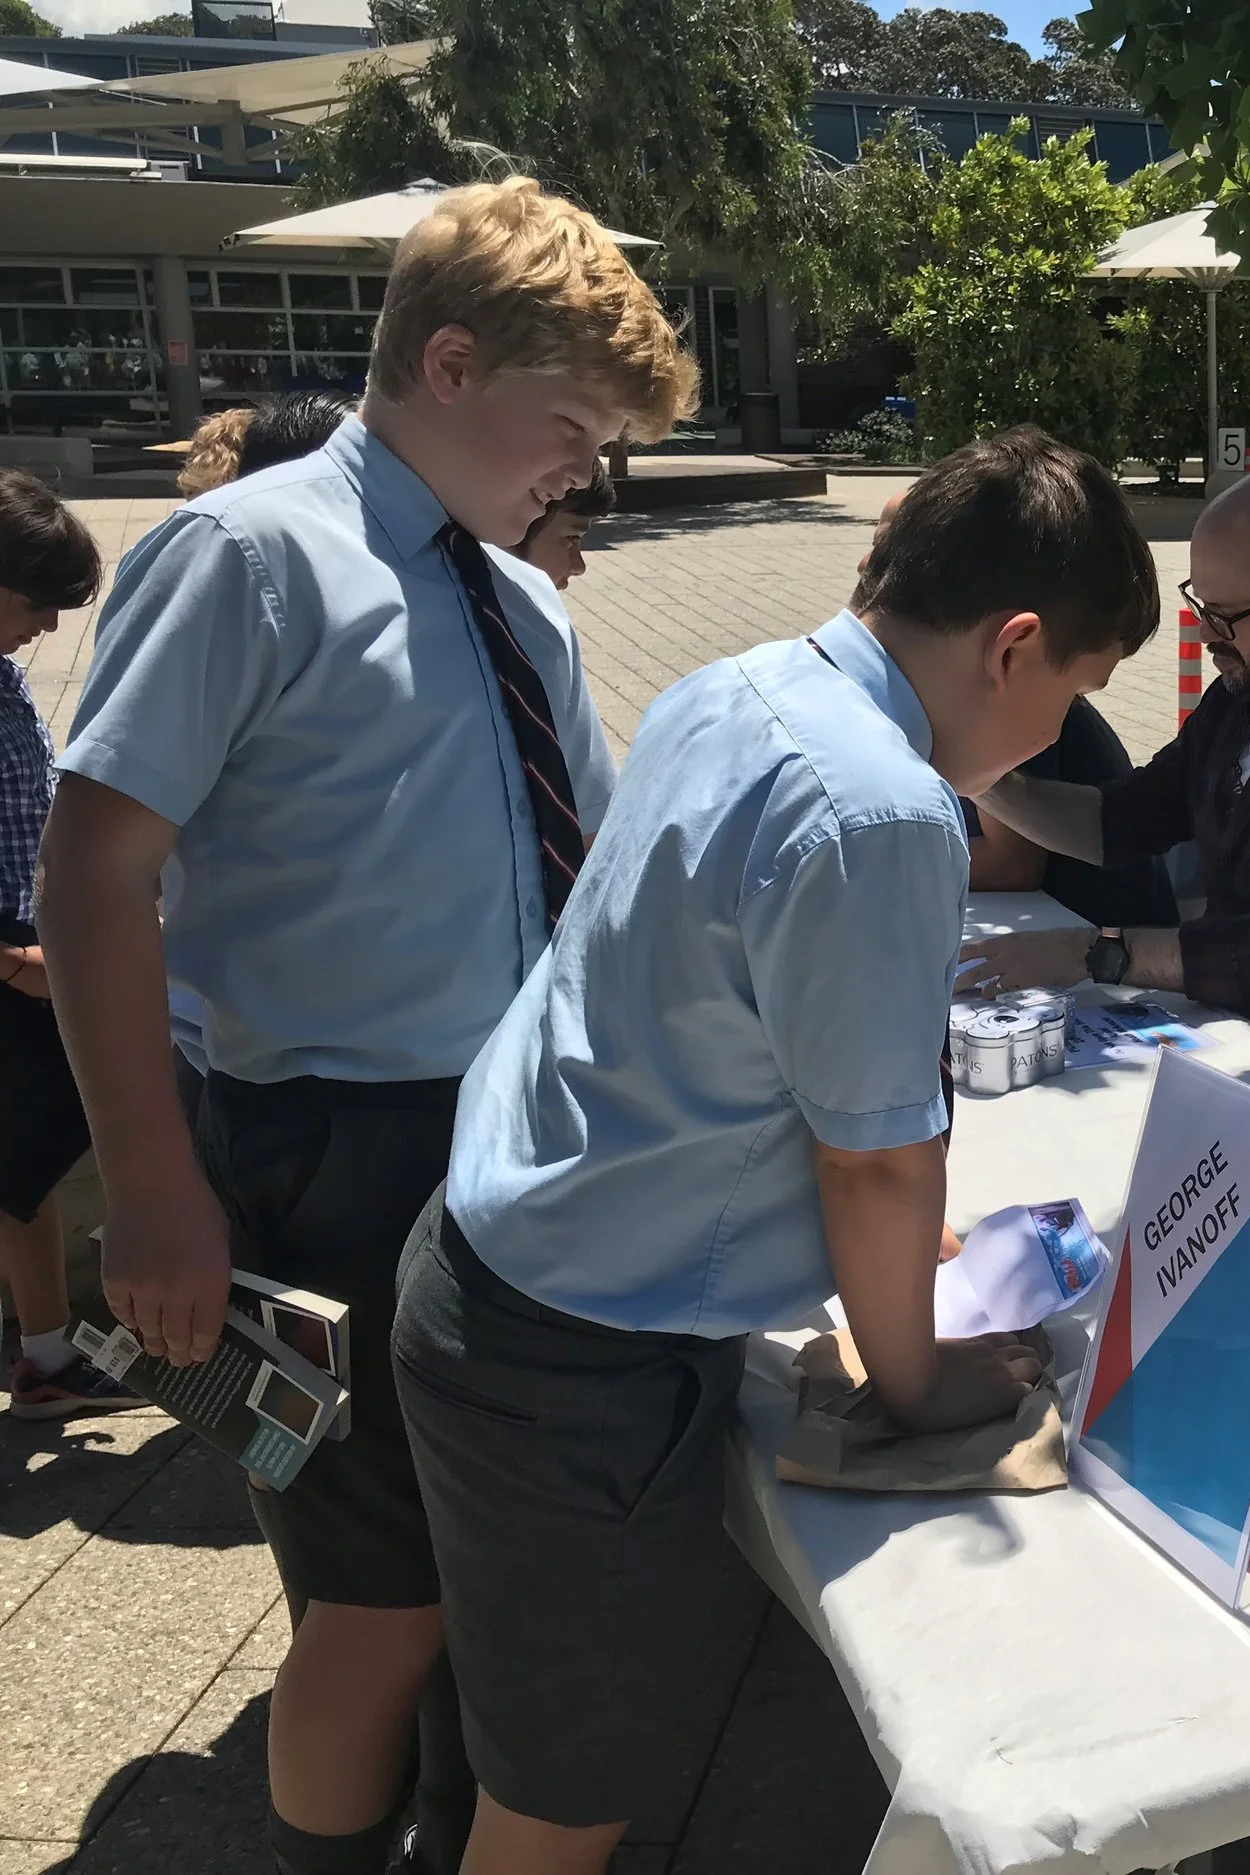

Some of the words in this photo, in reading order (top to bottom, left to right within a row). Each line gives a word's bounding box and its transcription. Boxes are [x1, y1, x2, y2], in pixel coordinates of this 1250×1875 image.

[1223, 434, 1241, 466] 5
[1010, 1044, 1058, 1070] PATONS
[1144, 1140, 1229, 1251] GEORGE
[1155, 1182, 1241, 1298] IVANOFF
